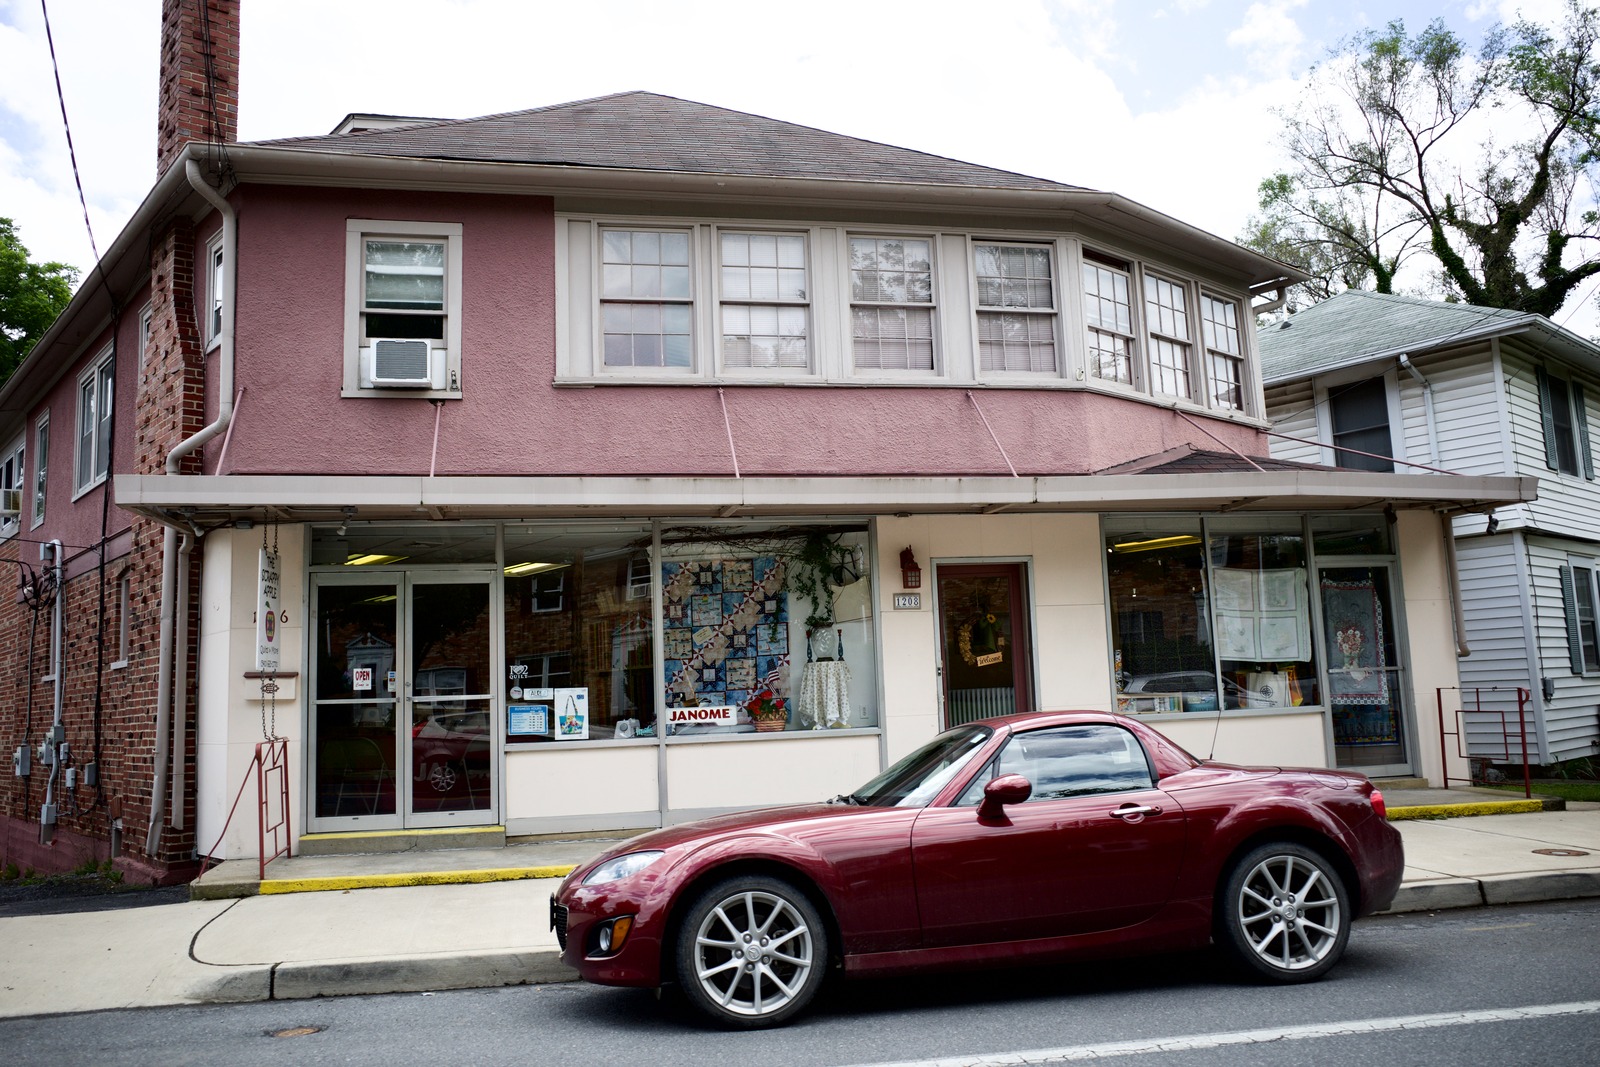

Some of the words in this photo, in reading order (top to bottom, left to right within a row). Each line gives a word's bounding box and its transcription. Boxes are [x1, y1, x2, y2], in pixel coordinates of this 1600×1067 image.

[264, 585, 277, 599] APPLE
[896, 597, 919, 606] 1208
[355, 671, 370, 681] OPEN
[669, 708, 731, 721] JANOME
